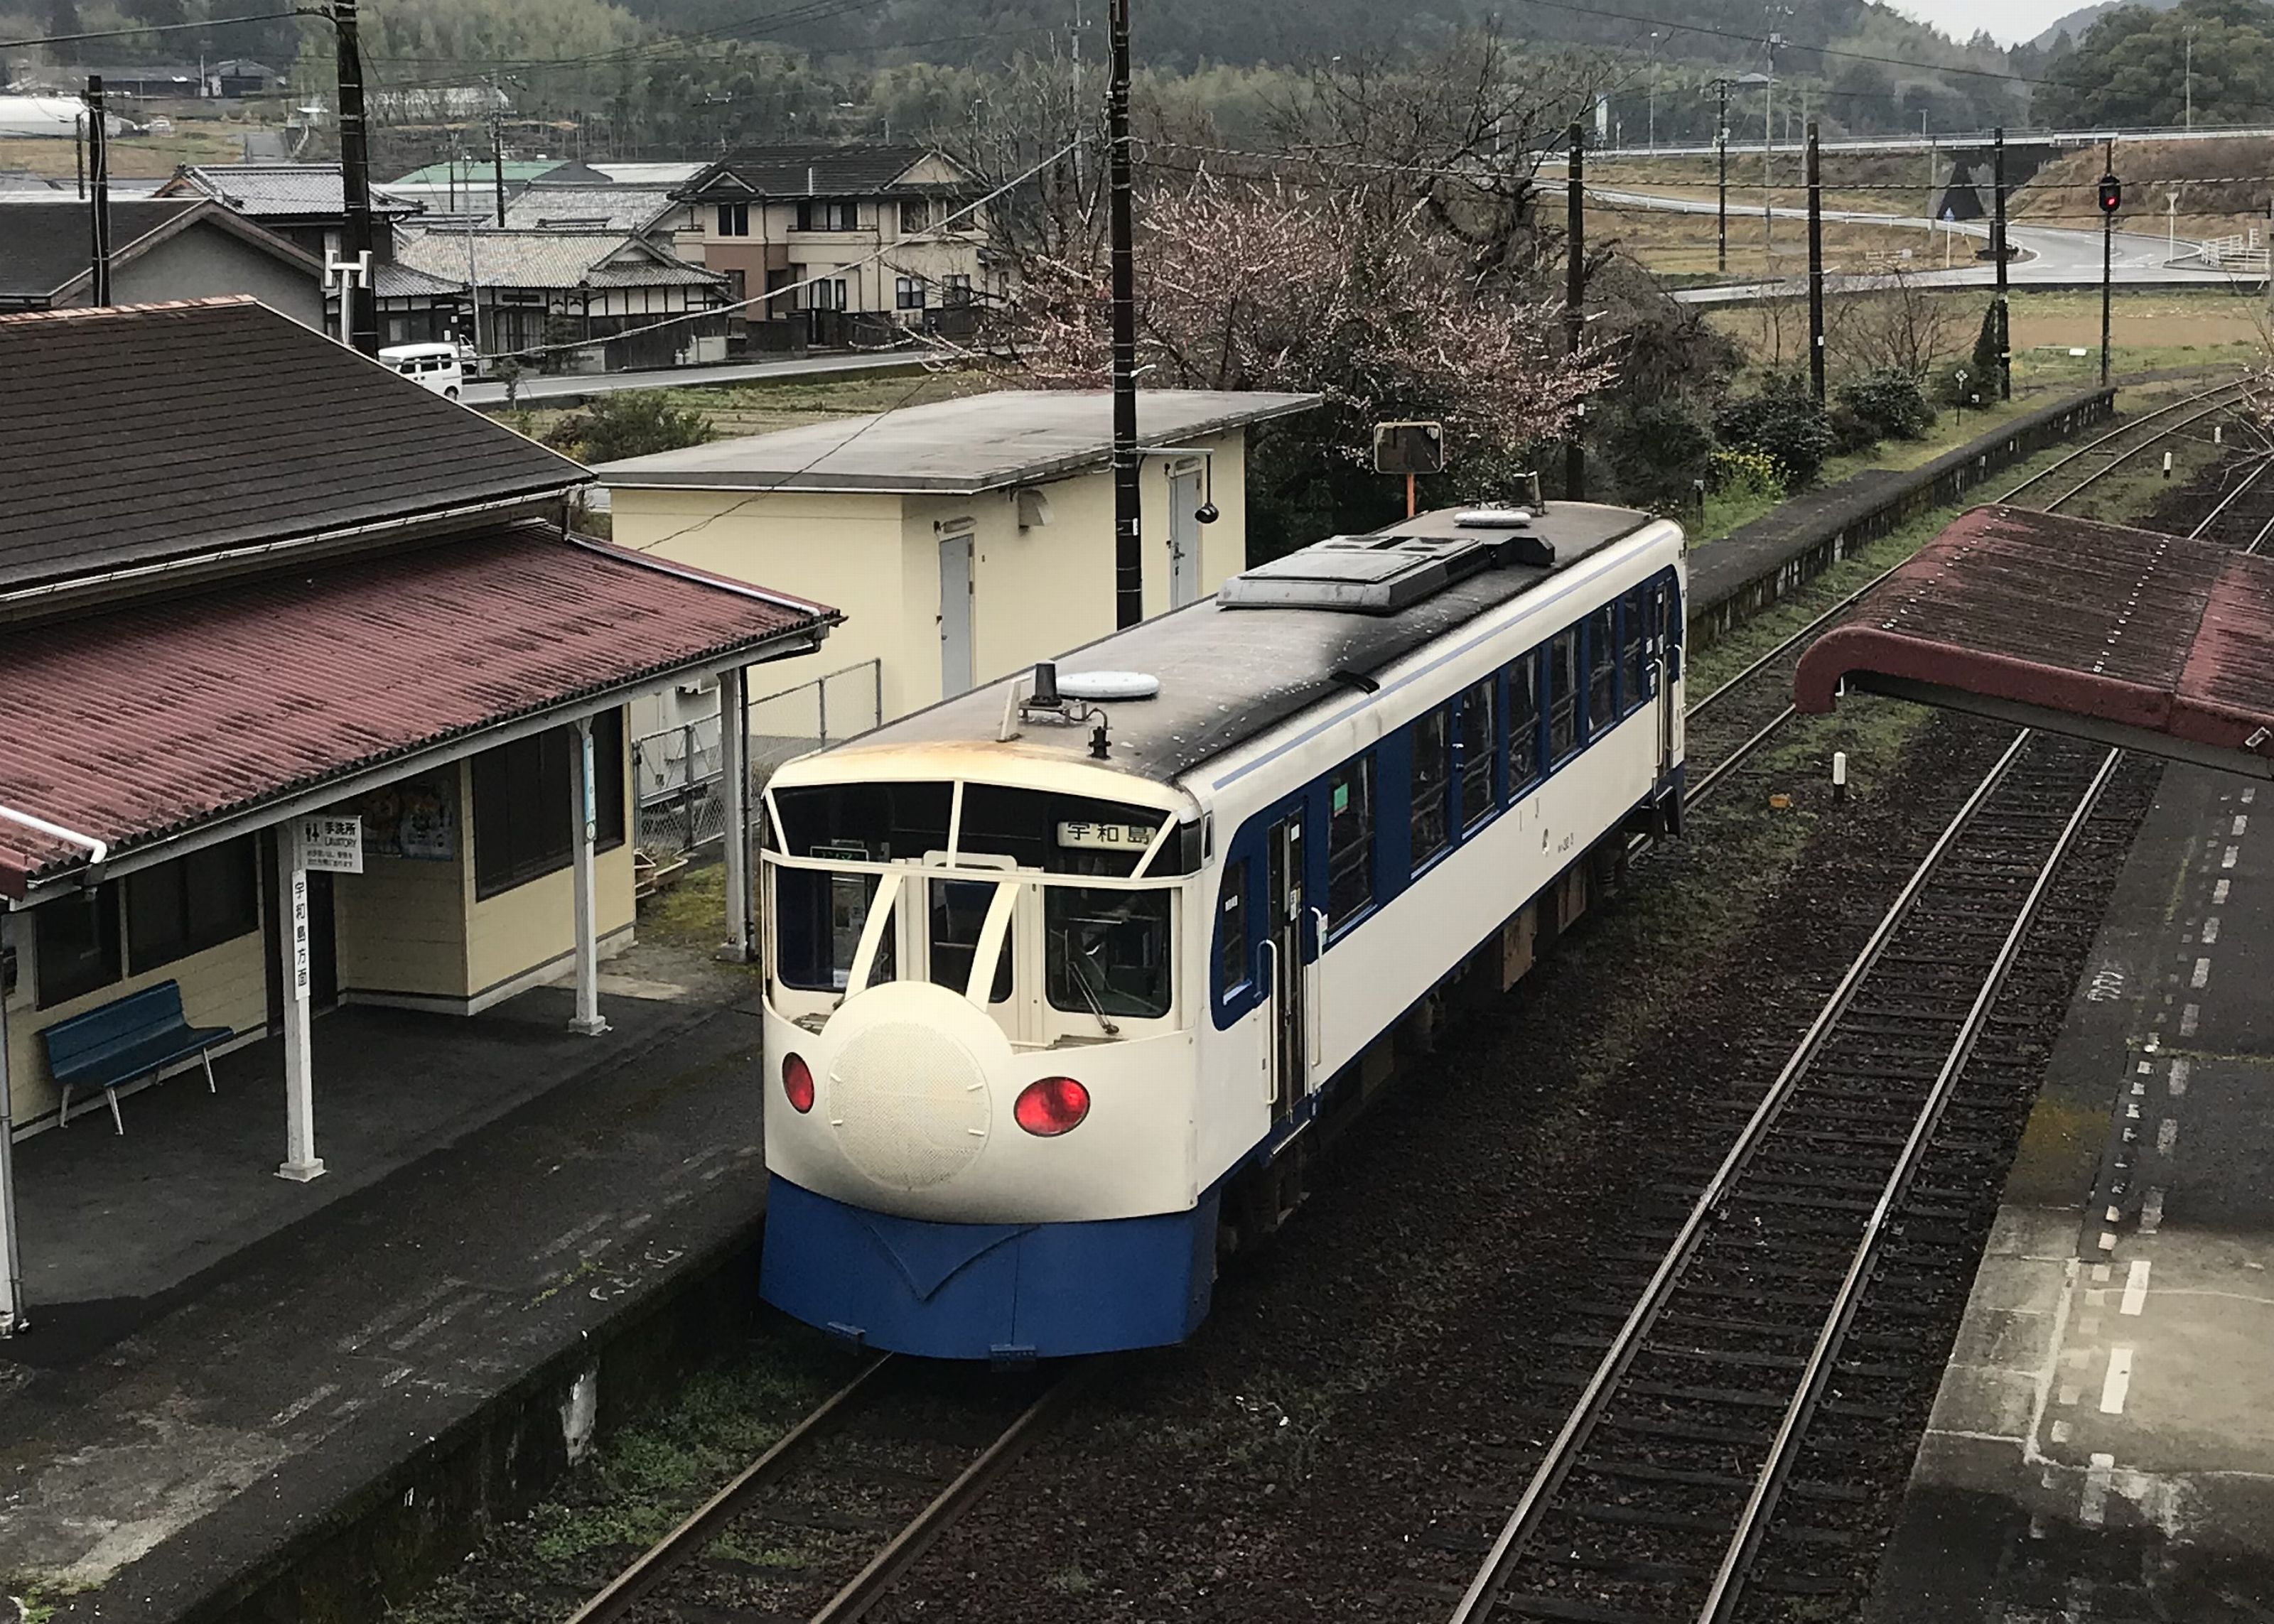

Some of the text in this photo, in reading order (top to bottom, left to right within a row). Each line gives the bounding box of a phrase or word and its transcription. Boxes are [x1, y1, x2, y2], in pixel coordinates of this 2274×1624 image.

[325, 821, 356, 835] 手洗所
[1067, 822, 1149, 845] 宇和島
[294, 881, 308, 987] 宇和島方面
